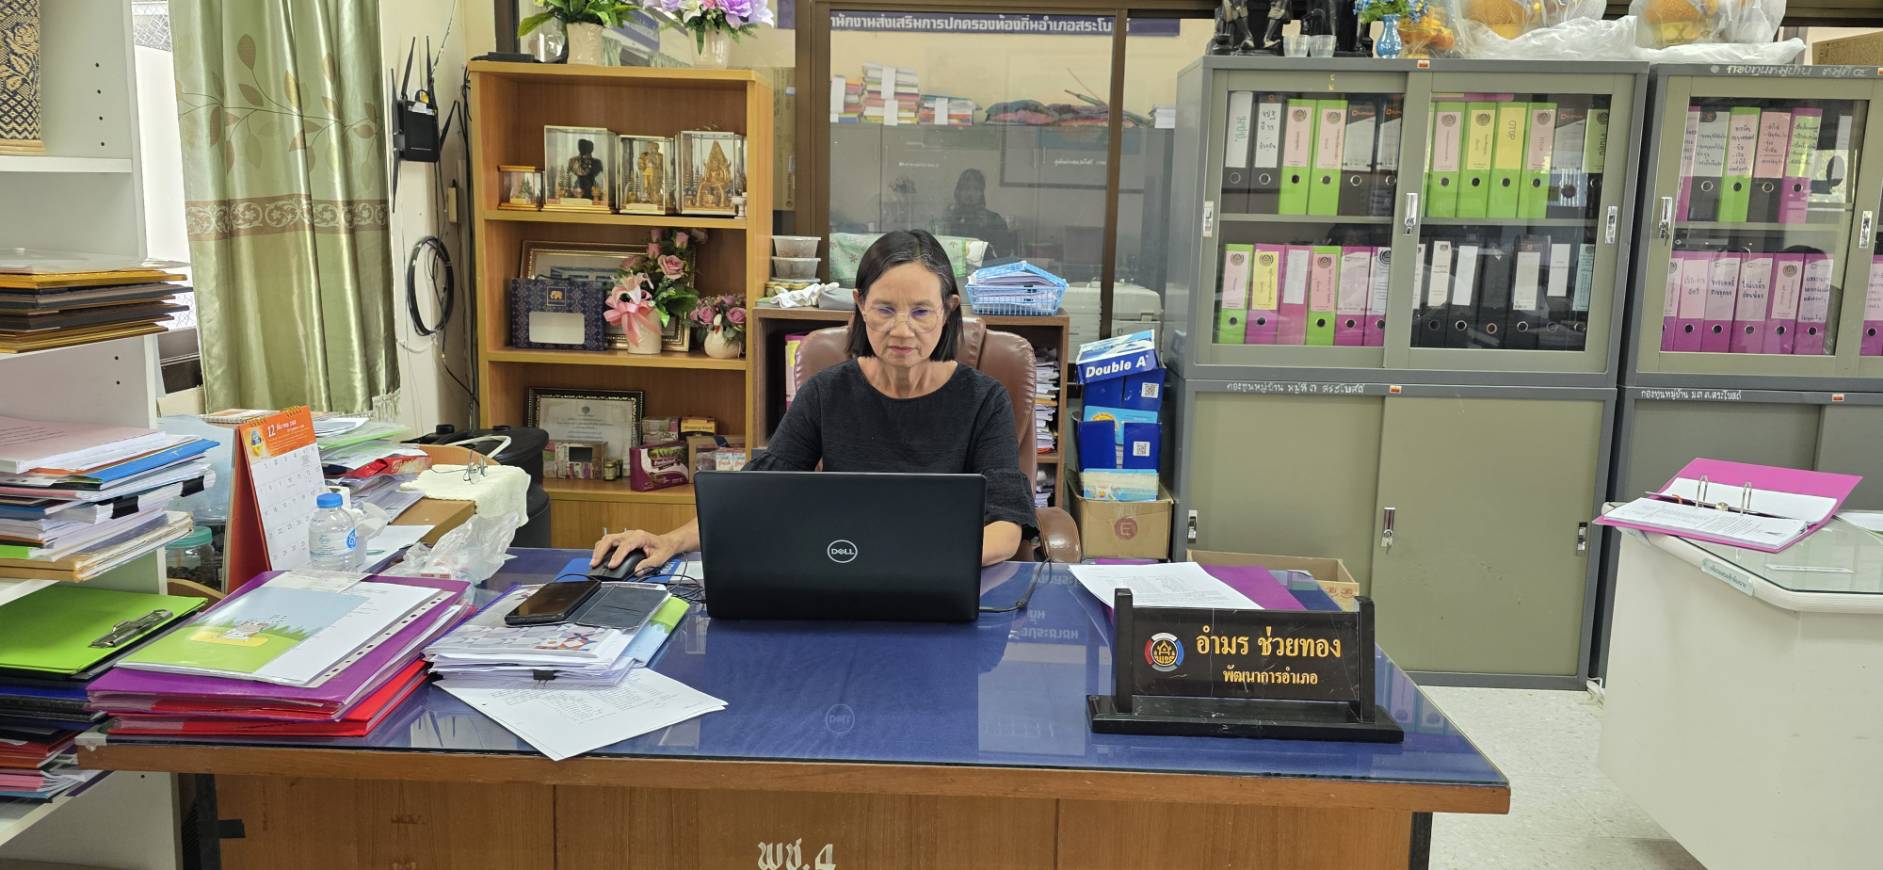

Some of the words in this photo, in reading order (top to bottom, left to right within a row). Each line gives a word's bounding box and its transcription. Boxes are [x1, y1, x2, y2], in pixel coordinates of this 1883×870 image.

[1085, 359, 1132, 378] Double
[1196, 625, 1249, 655] อำมร
[1257, 626, 1342, 657] ช่วยทอง
[1222, 664, 1319, 685] พัฒนาการอำเภอ
